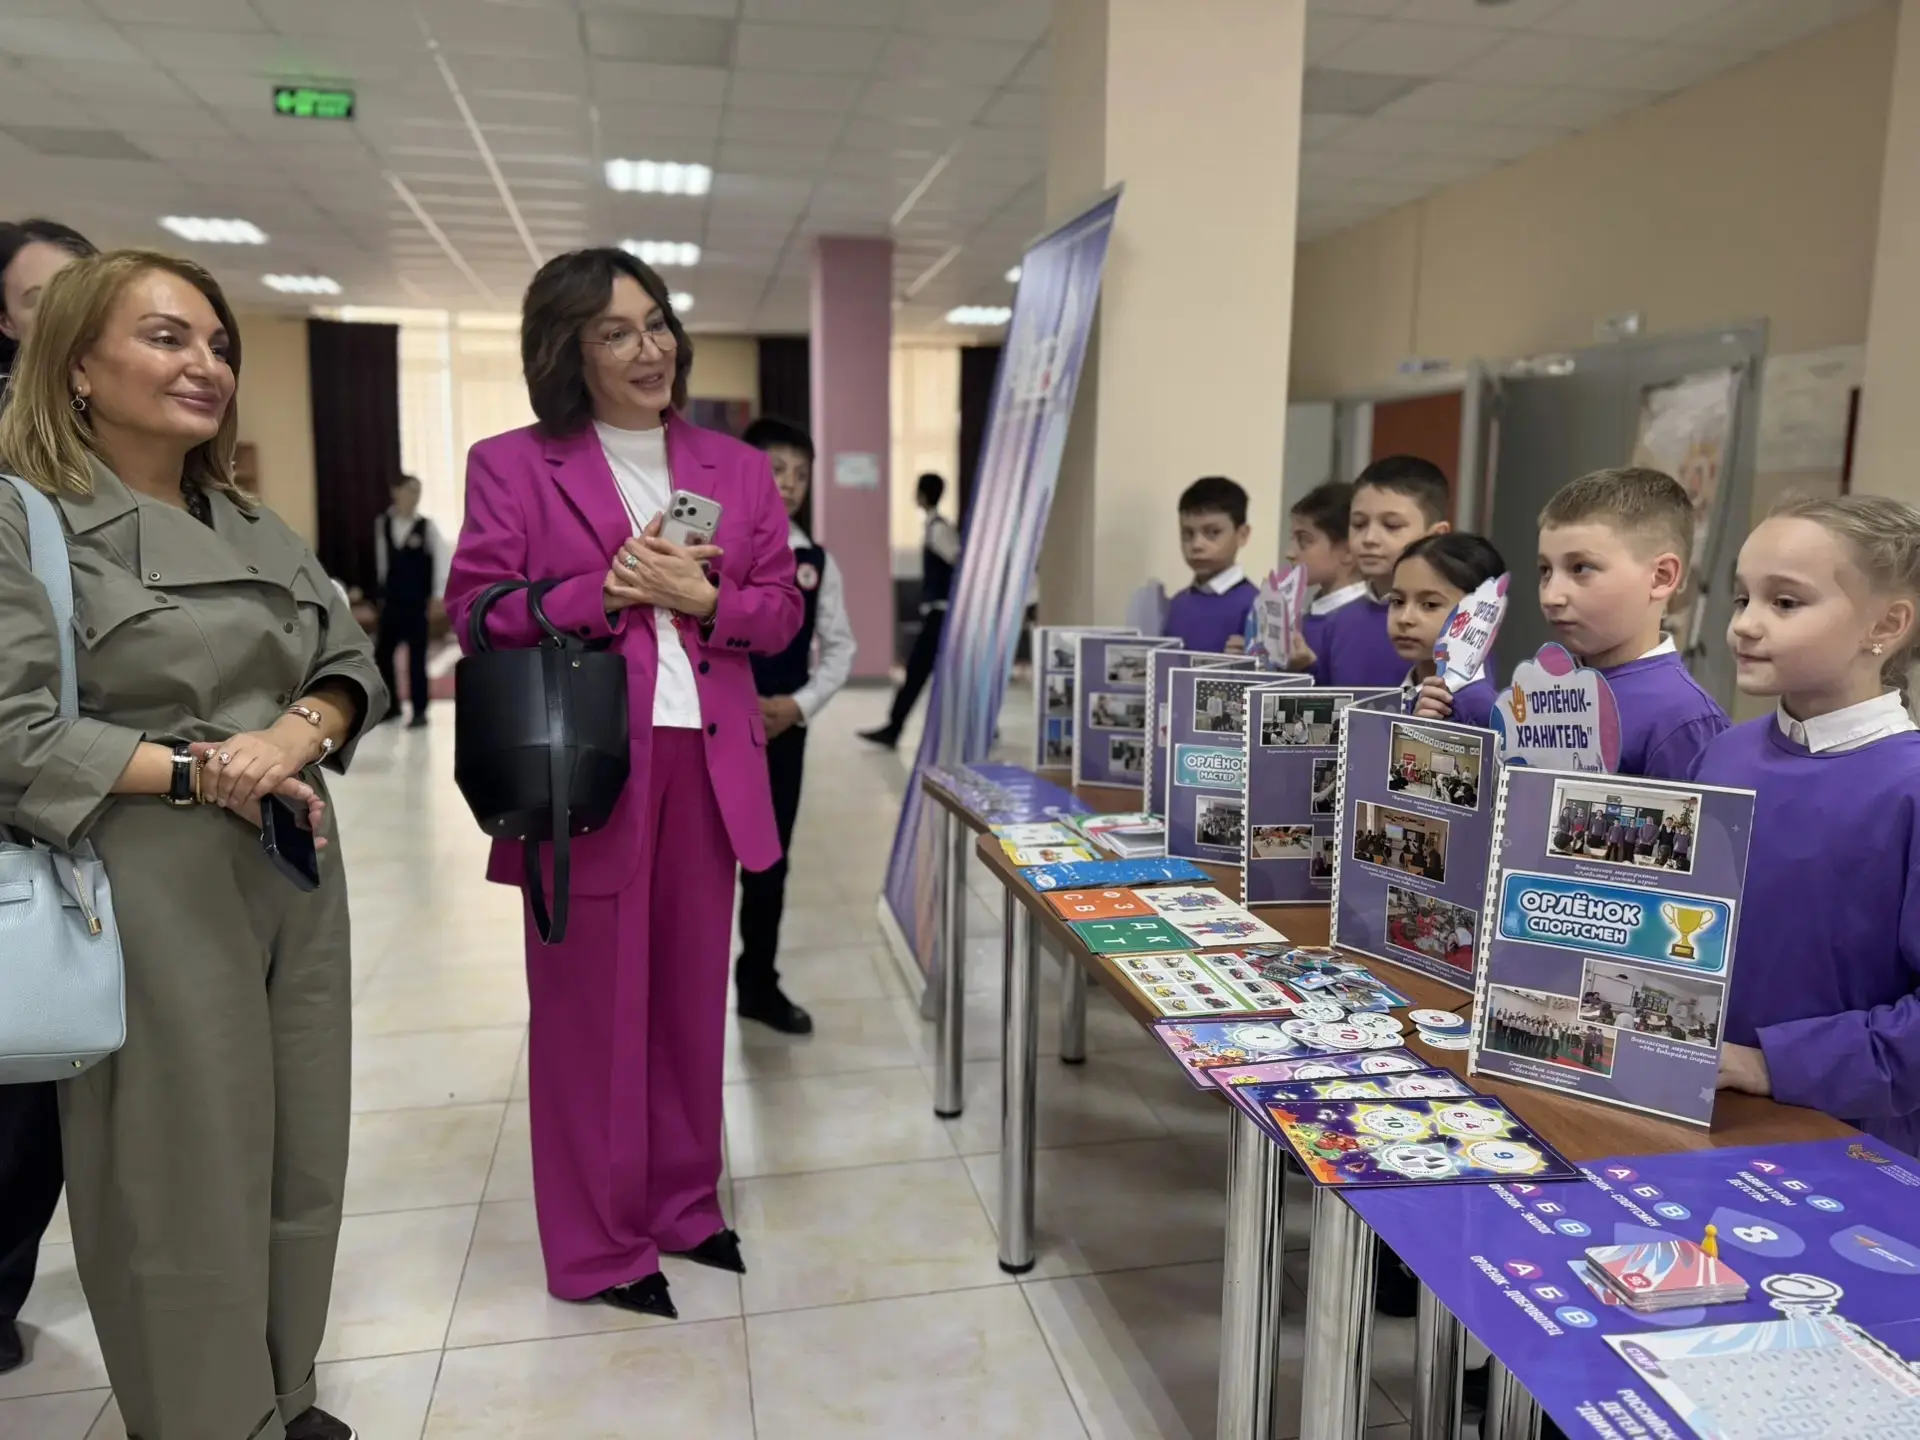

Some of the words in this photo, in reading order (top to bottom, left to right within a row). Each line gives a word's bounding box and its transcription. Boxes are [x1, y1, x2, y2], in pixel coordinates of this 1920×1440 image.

[1526, 684, 1591, 714] "ОРЛЁНОК-
[1516, 724, 1592, 749] ХРАНИТЕЛЬ"
[1186, 754, 1242, 771] ОРЛЁНО
[1200, 770, 1235, 782] МАСТЕР
[1074, 904, 1096, 912] В
[1520, 890, 1641, 926] ОРЛЁНОК
[1528, 916, 1627, 944] СПОРТСМЕН
[1340, 1029, 1359, 1040] 10
[1630, 1035, 1670, 1049] Внеклассное
[1671, 1046, 1717, 1060] мероприятие
[1383, 1116, 1405, 1129] 10
[1607, 1168, 1631, 1180] А
[1633, 1186, 1659, 1198] Б
[1726, 1178, 1770, 1203] ДЕТСТВА
[1736, 1171, 1797, 1207] НАВИГАТОРЫ
[1536, 1202, 1562, 1213] Б
[1660, 1205, 1685, 1217] В
[1520, 1211, 1556, 1235] ЭКОЛОГ
[1560, 1222, 1585, 1234] В
[1732, 1225, 1780, 1244] 8
[1508, 1262, 1536, 1276] А
[1470, 1255, 1511, 1286] ОРЛЁНОК
[1503, 1289, 1565, 1337] ДОБРОВОЛЕЦ
[1535, 1286, 1565, 1300] Б
[1562, 1311, 1590, 1325] В
[1626, 1347, 1660, 1370] СТАРТ
